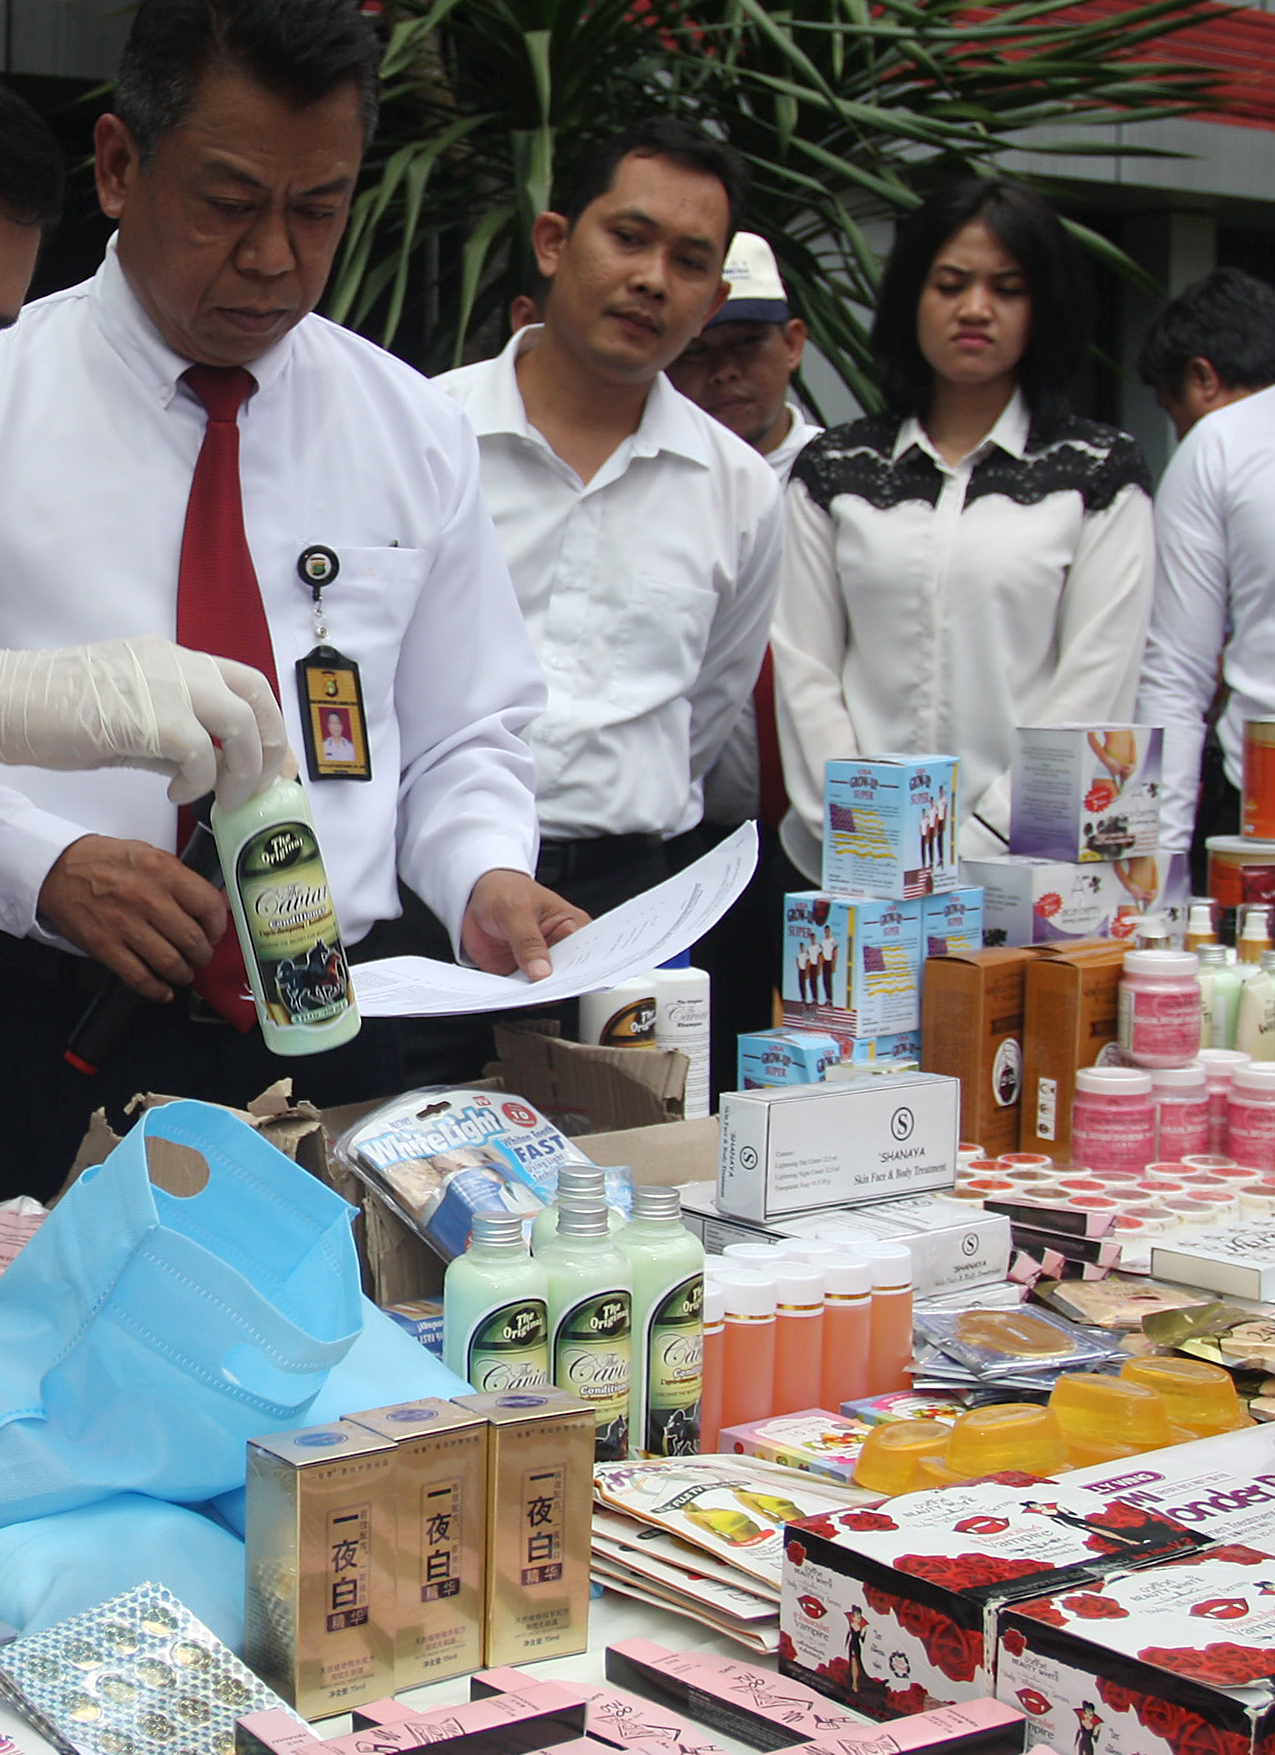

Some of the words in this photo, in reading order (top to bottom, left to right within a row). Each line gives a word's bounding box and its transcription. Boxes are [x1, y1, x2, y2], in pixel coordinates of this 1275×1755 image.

[787, 908, 813, 926] GROW-U
[510, 1110, 530, 1120] 10
[513, 1134, 565, 1163] FAST
[853, 1174, 869, 1186] Skin
[870, 1172, 887, 1184] Face
[887, 1171, 894, 1180] &
[895, 1166, 913, 1180] Body
[913, 1163, 947, 1176] Treatment
[693, 1286, 703, 1302] Th
[516, 1312, 535, 1329] The
[602, 1302, 623, 1318] The
[503, 1318, 543, 1340] Original
[579, 1381, 629, 1396] Conditio
[1147, 1485, 1262, 1523] onder
[527, 1473, 556, 1563] 一夜白
[425, 1488, 452, 1583] 一夜白
[983, 1529, 1054, 1550] Vampire
[331, 1514, 359, 1610] 一夜白
[794, 1618, 830, 1642] Vampire
